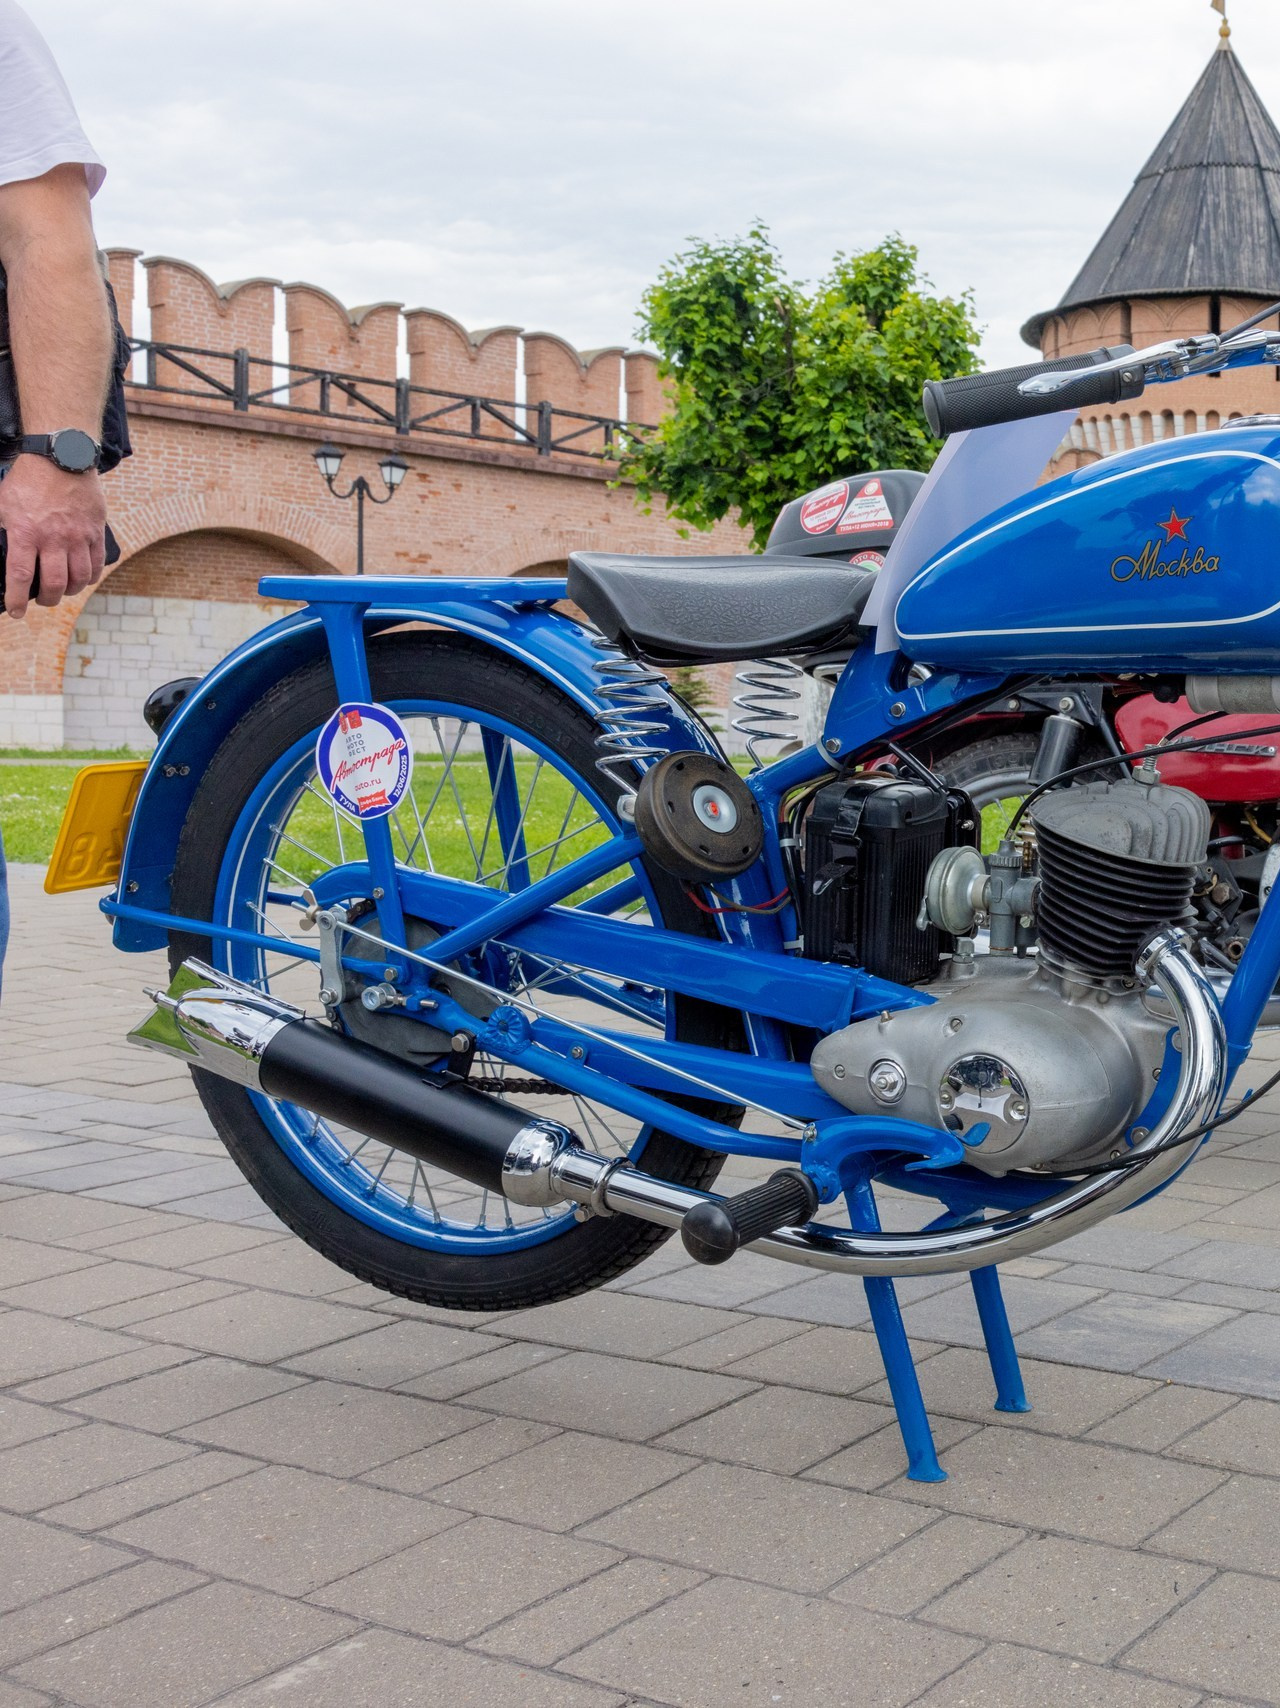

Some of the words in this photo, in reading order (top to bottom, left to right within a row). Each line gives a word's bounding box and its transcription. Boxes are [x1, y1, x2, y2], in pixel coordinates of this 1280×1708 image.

[1110, 539, 1221, 582] Москва
[345, 732, 362, 744] АВТО
[347, 739, 365, 751] МОТО
[331, 739, 405, 792] Автострада
[393, 754, 408, 798] 12/06/2025
[339, 794, 356, 813] ТУЛА
